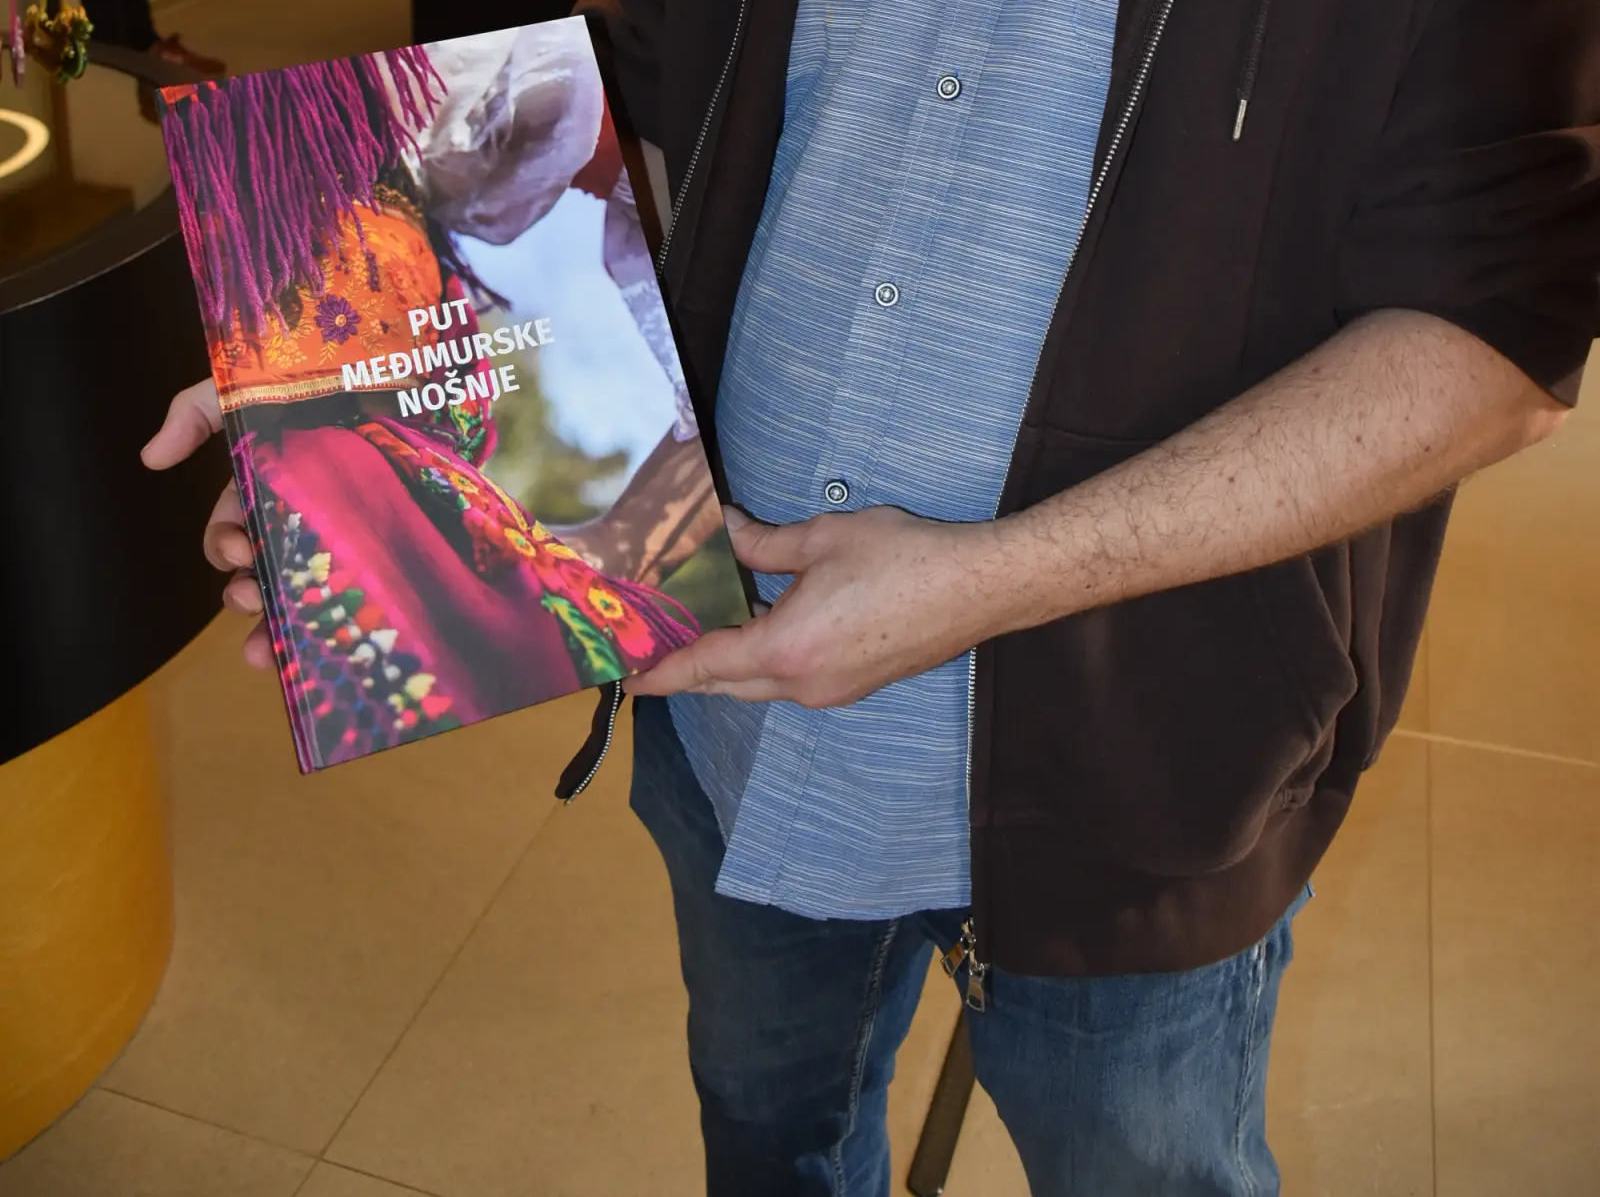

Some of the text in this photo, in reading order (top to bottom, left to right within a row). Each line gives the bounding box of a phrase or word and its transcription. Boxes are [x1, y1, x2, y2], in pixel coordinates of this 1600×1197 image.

[407, 298, 470, 336] PUT
[341, 318, 556, 391] MEĐIMURSKE
[397, 364, 521, 418] NOŠNJE
